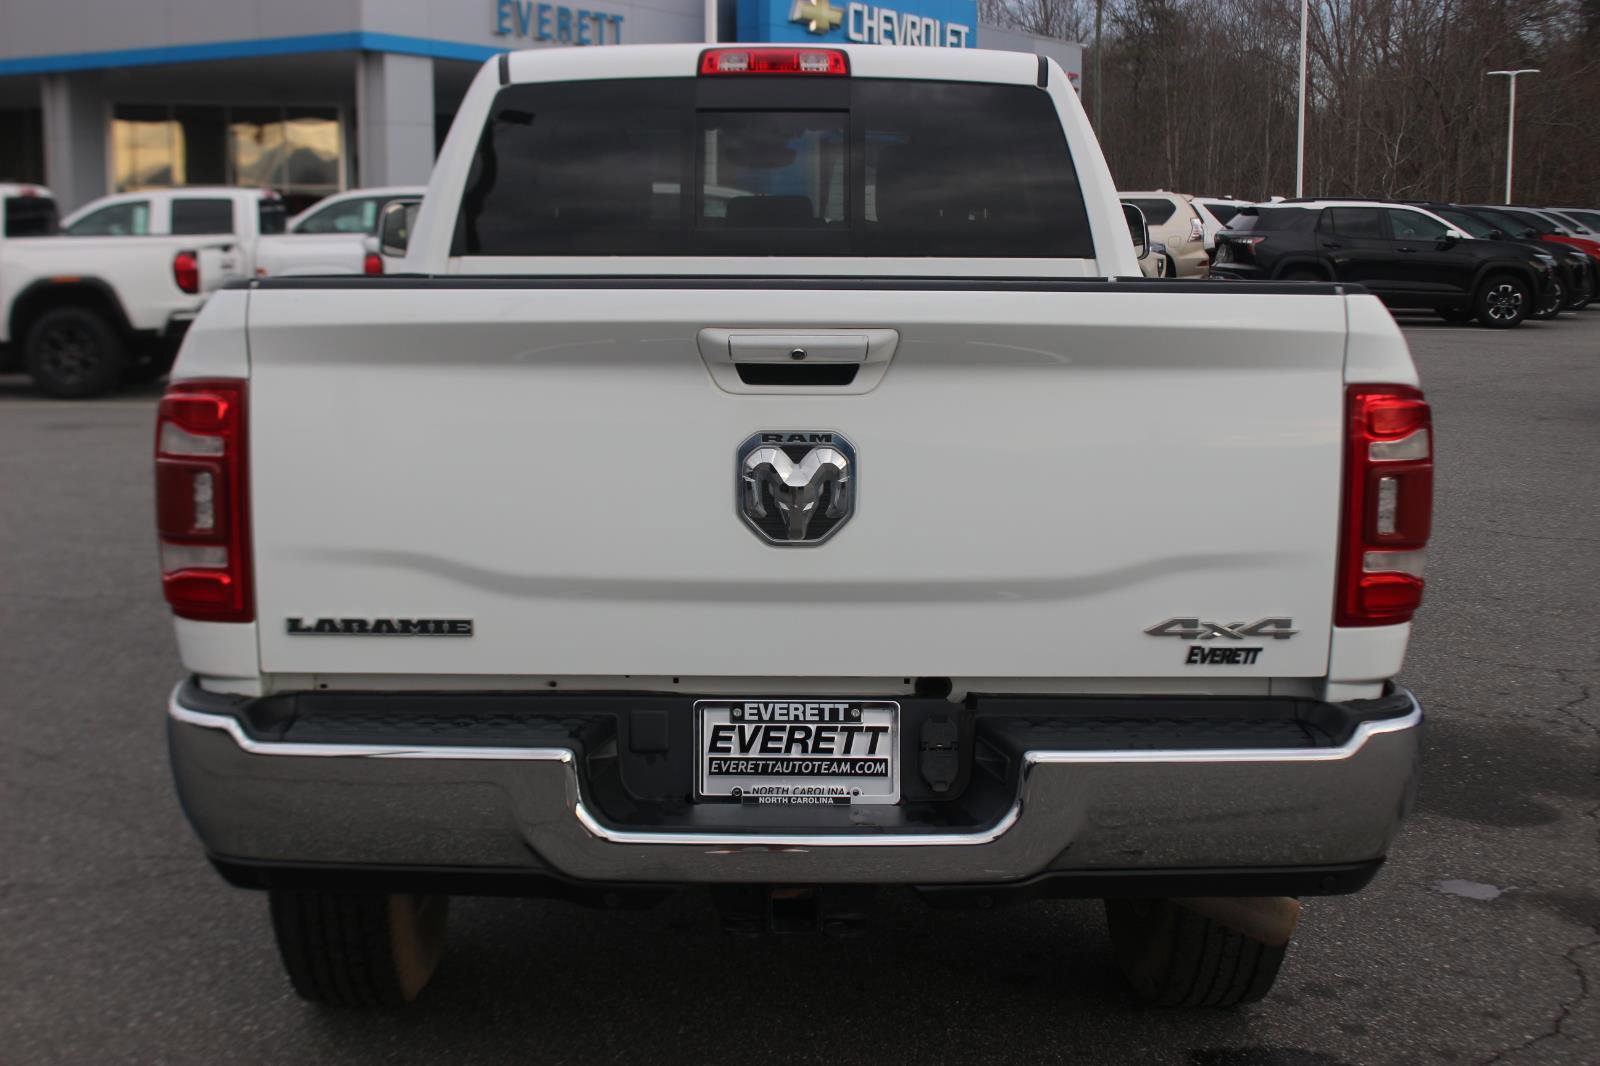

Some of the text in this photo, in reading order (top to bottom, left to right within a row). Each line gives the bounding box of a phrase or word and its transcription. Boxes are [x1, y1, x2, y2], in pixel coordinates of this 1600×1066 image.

[496, 0, 624, 45] EVERETT
[848, 2, 970, 48] CHEVROLET
[761, 434, 832, 443] RAM
[286, 617, 474, 636] LARAMIE
[1185, 645, 1263, 665] EVERETT
[744, 703, 849, 721] EVERETT
[707, 724, 889, 755] EVERETT
[710, 760, 886, 774] EVERETTAUTOTEAM.COM
[752, 786, 845, 795] NORTH CAROLINA
[759, 796, 834, 804] NORTH CAROLINA
